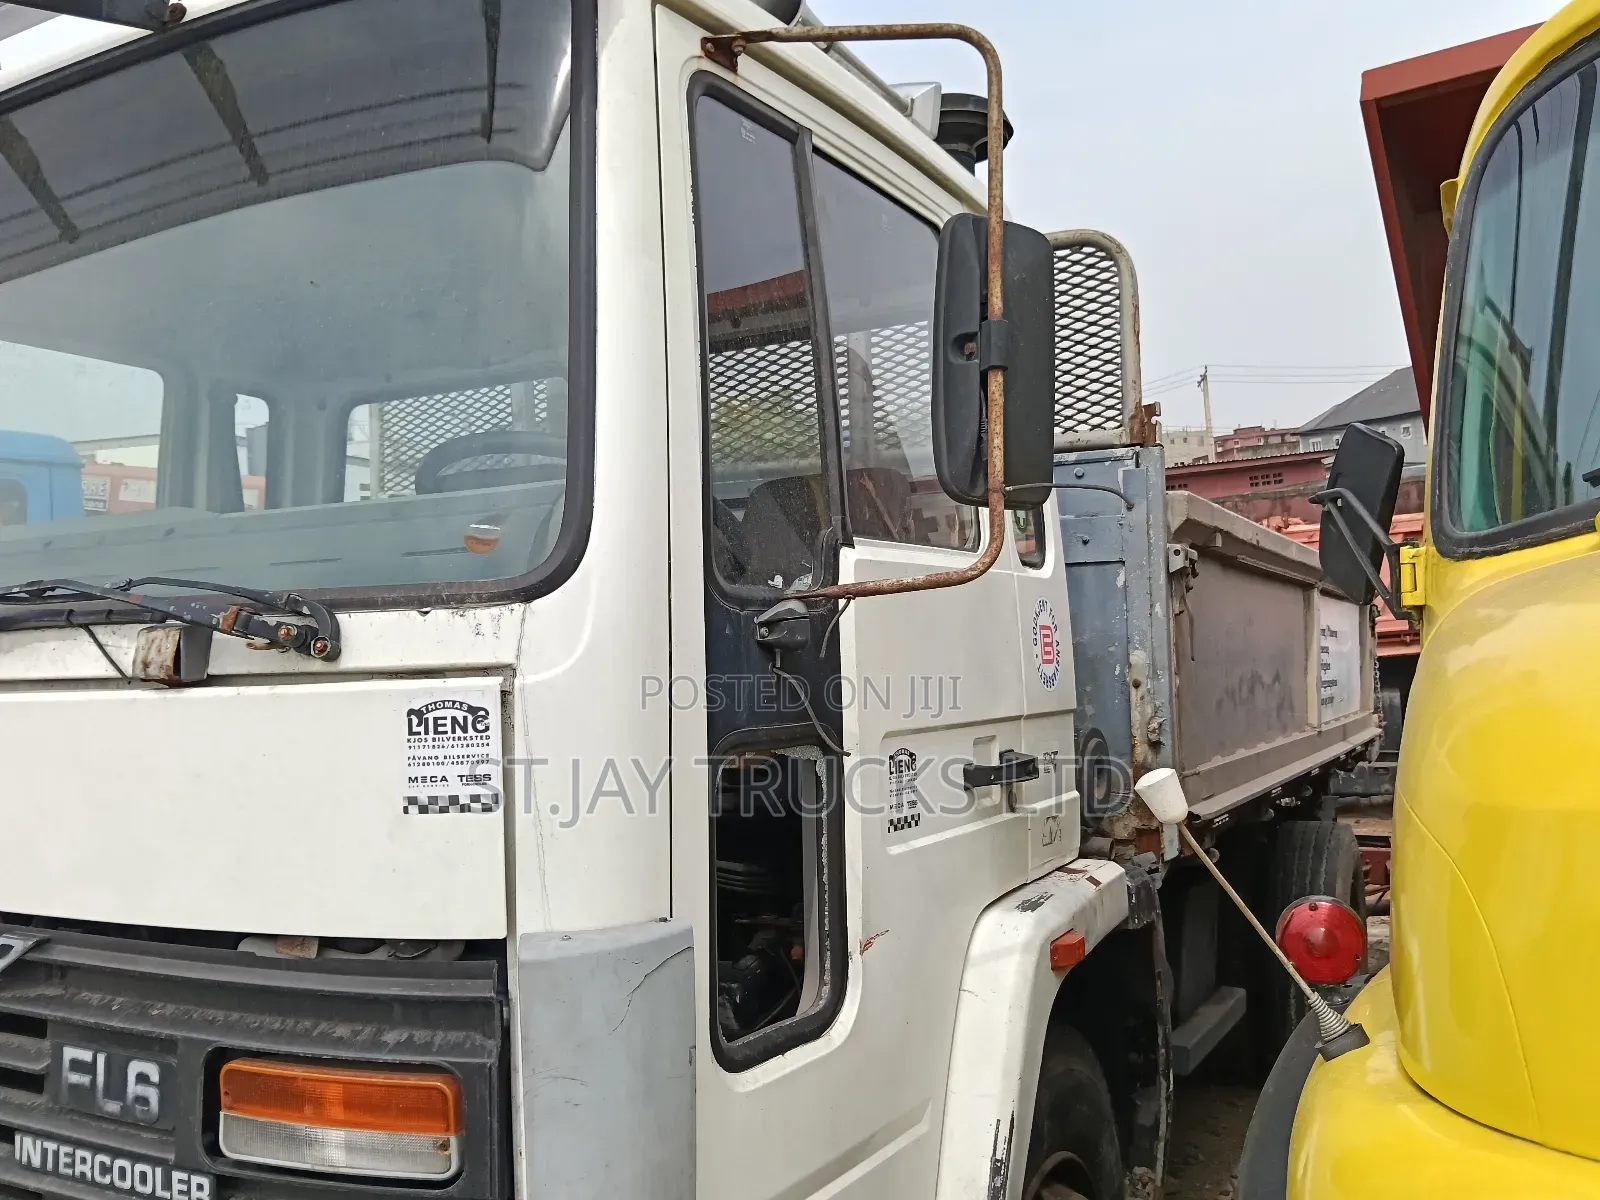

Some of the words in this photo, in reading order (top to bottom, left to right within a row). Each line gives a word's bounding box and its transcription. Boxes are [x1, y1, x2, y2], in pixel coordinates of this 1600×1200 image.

[420, 701, 469, 714] THOMAS
[407, 714, 490, 736] LIENG
[432, 735, 491, 743] BILVERKSTED
[457, 774, 492, 783] TESS
[62, 1045, 161, 1125] FL6
[14, 1134, 211, 1200] INTERCOOLER
